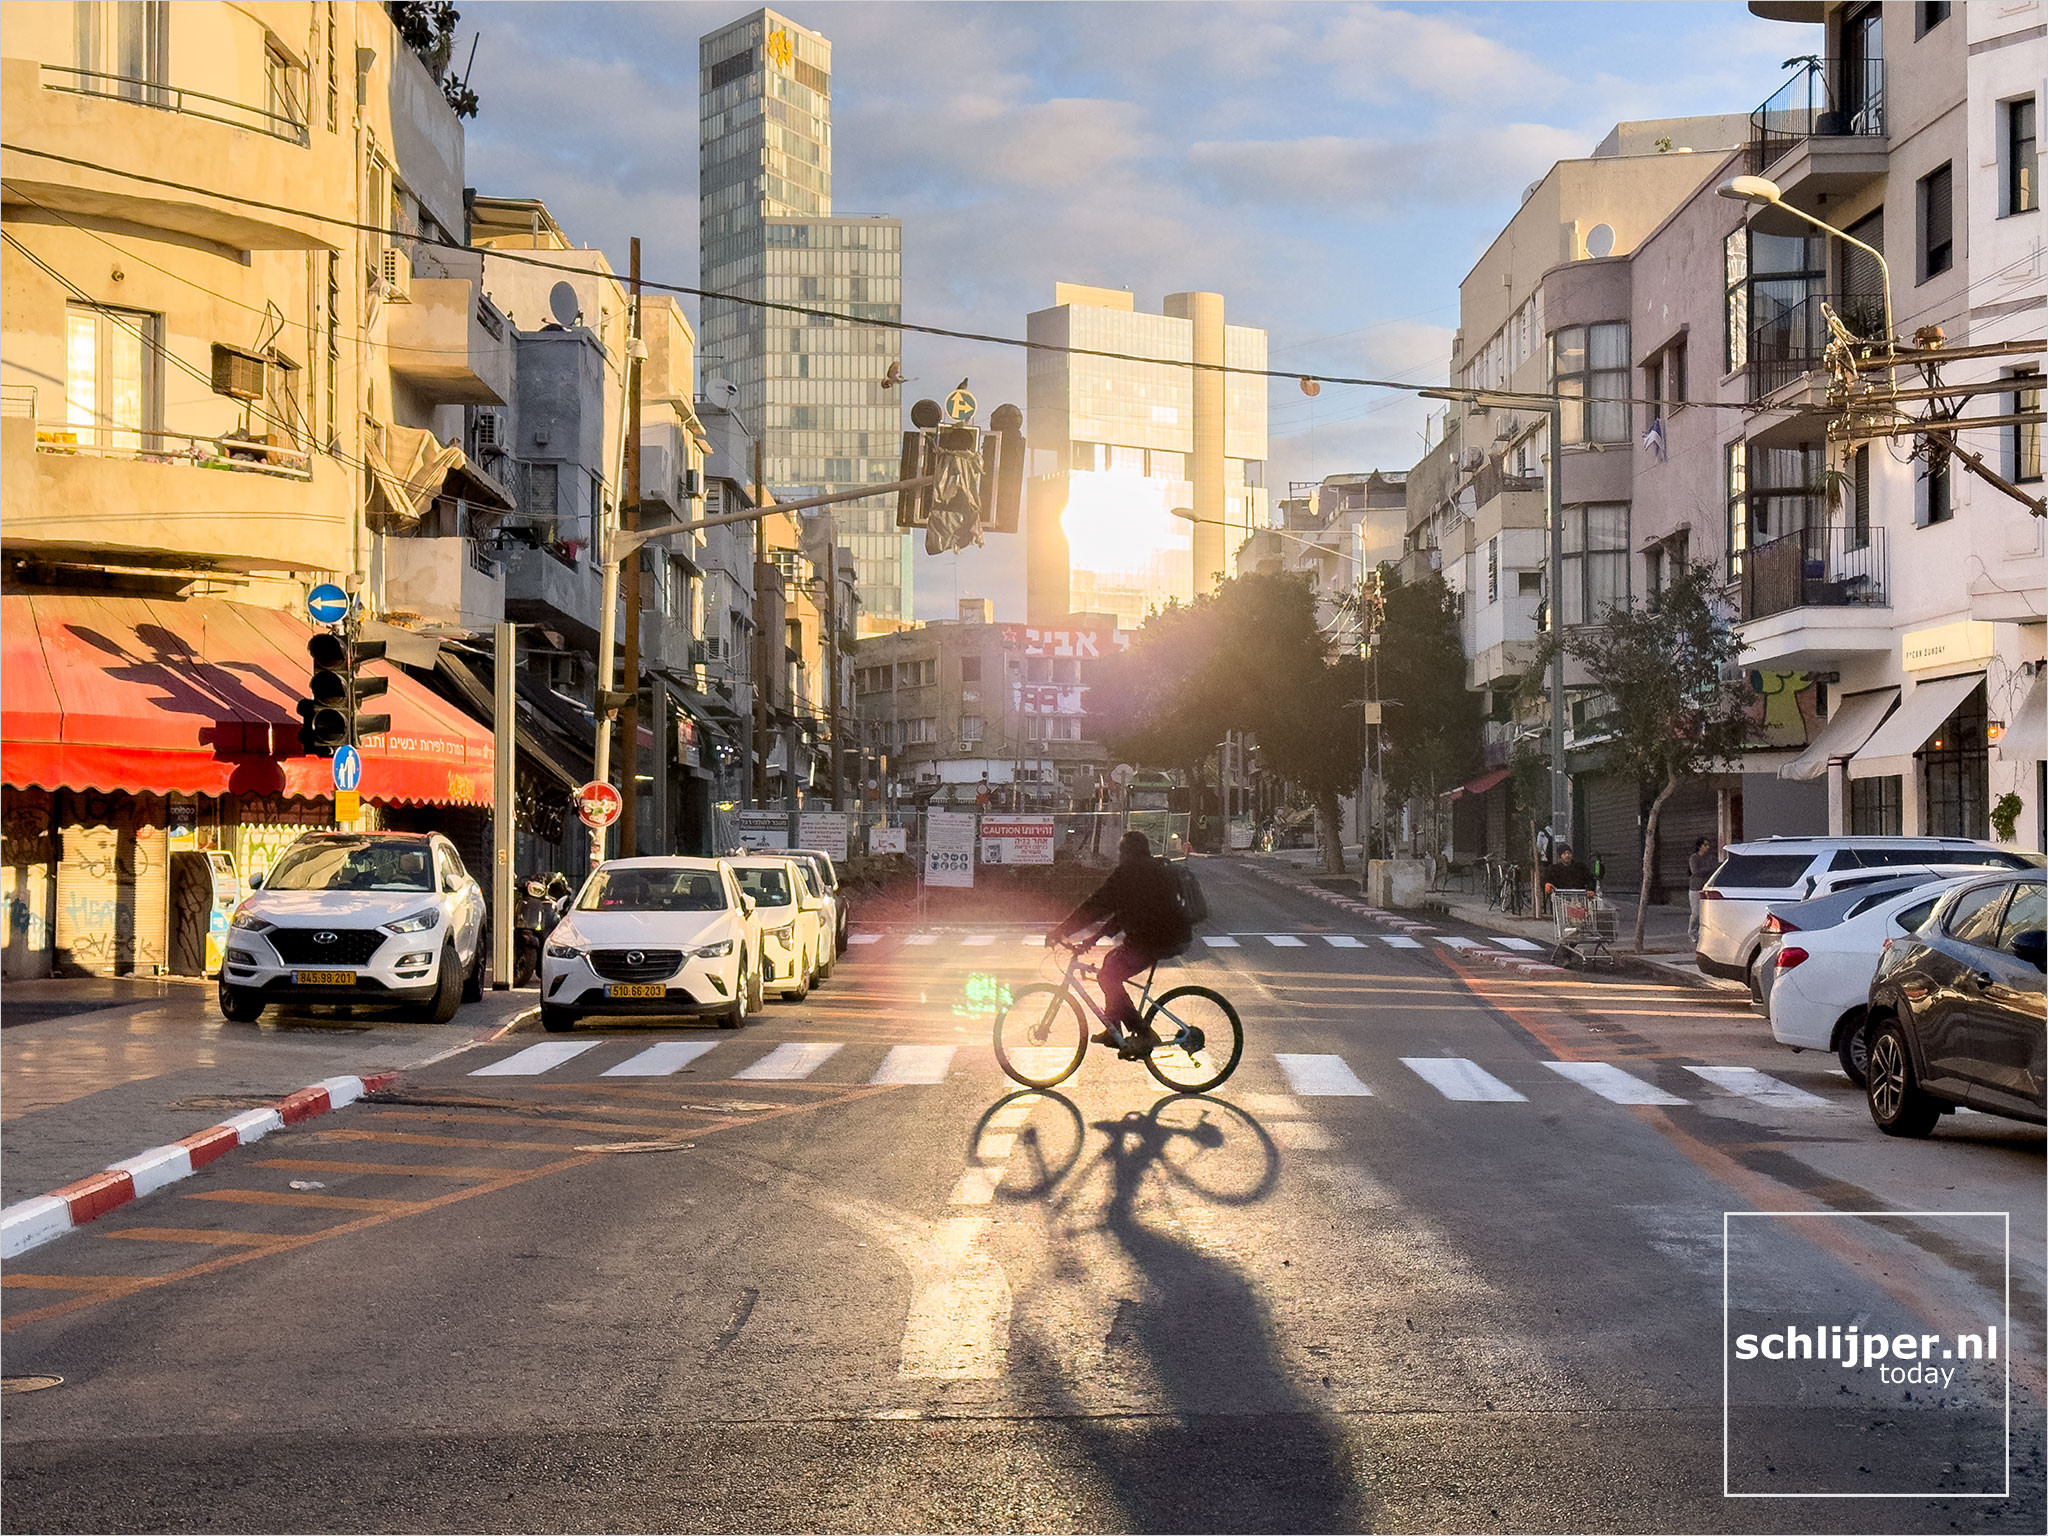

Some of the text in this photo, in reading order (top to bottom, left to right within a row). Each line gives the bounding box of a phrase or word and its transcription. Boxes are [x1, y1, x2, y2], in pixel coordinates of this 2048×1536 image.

[364, 735, 385, 748] ותב
[390, 736, 417, 750] יבשים
[420, 738, 445, 753] לפירות
[982, 826, 1020, 835] CAUTION
